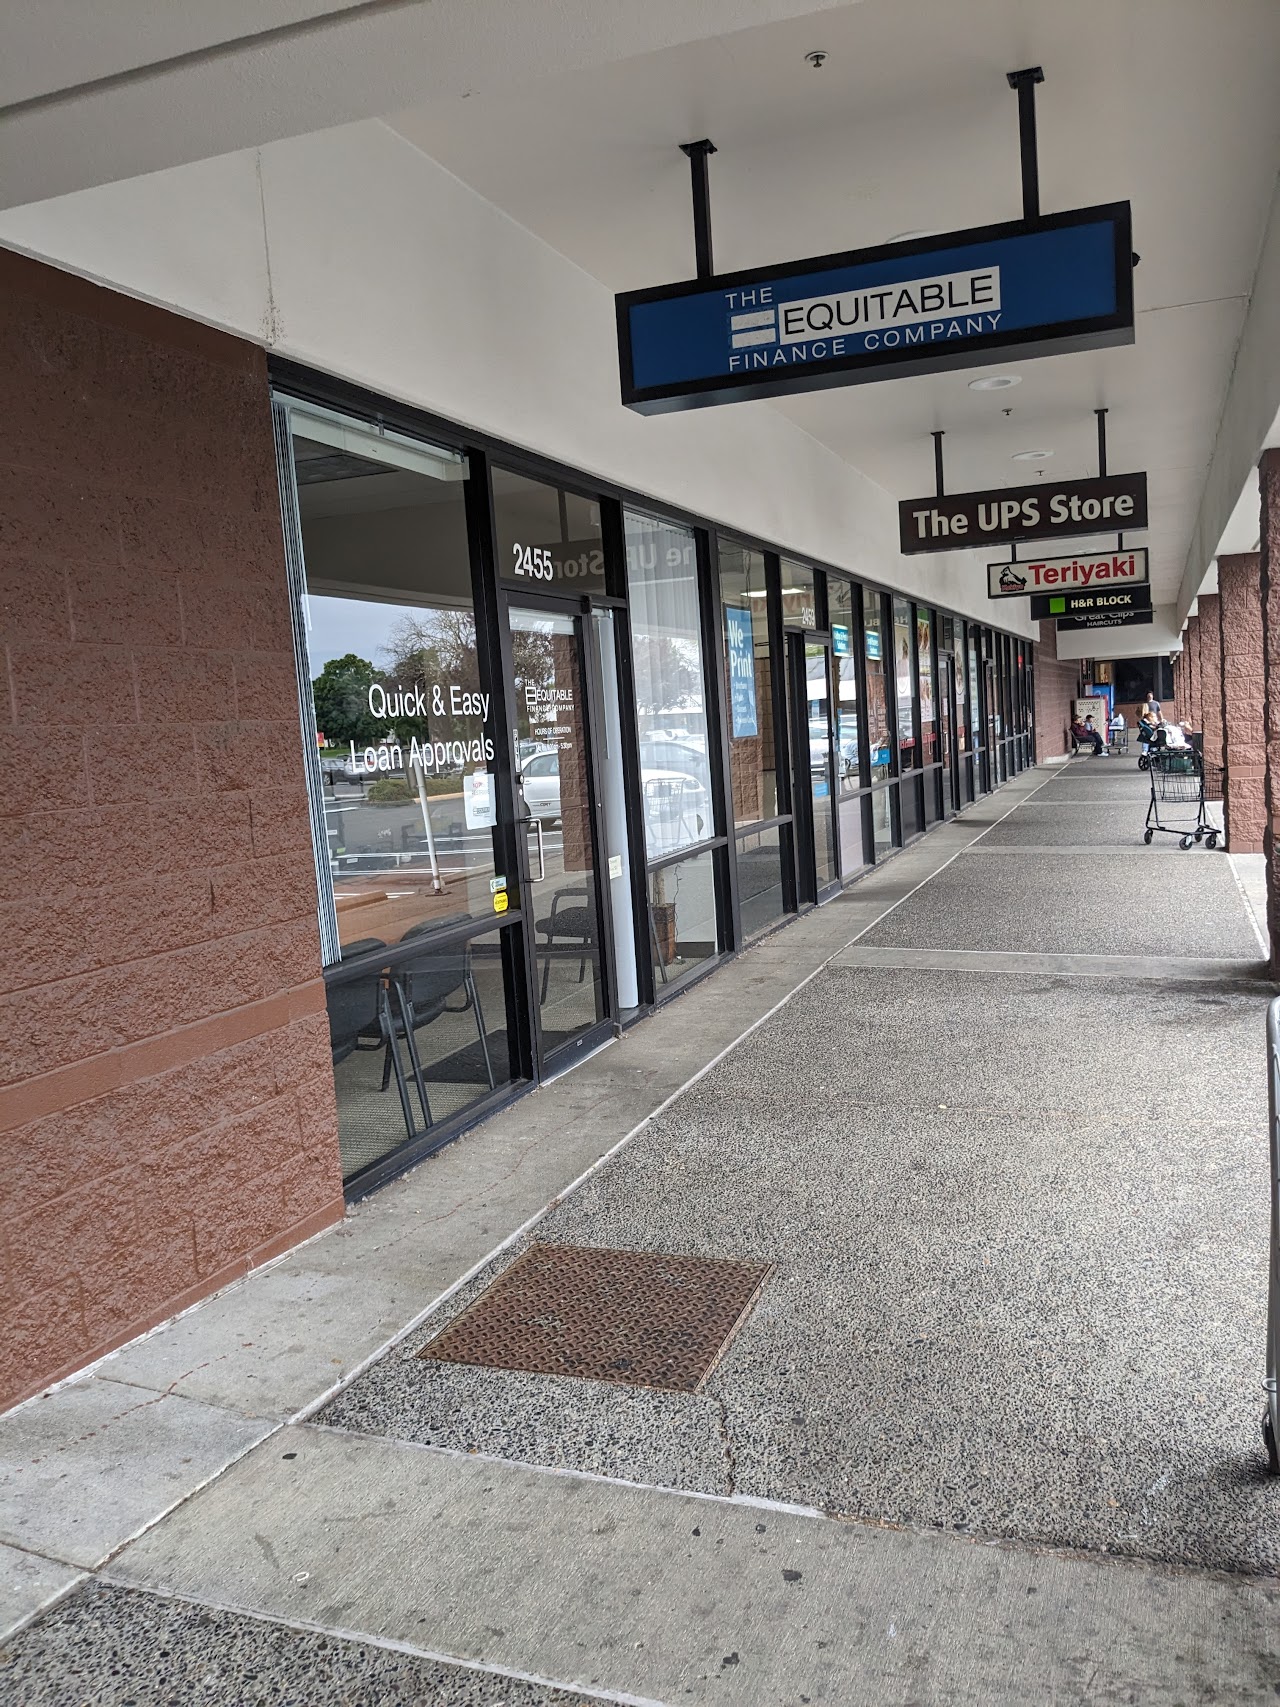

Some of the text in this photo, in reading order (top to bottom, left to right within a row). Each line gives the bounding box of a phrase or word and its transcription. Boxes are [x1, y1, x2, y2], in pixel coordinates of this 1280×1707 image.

[725, 287, 773, 309] THE
[784, 274, 994, 335] EQUITABLE
[728, 314, 1001, 372] FINANCE COMPANY
[912, 494, 1134, 539] The UPS Store
[512, 542, 554, 581] 2455
[1028, 554, 1135, 585] Teriyaki
[1070, 594, 1132, 609] H&R BLOCK
[728, 620, 744, 649] We
[1086, 619, 1122, 628] HAIRCUTS
[730, 649, 753, 678] Print
[368, 683, 490, 722] Quick & Easy
[537, 689, 573, 701] EQUITABLE
[534, 727, 548, 735] HOURS
[350, 739, 403, 774] Loan
[408, 732, 495, 774] Approvals
